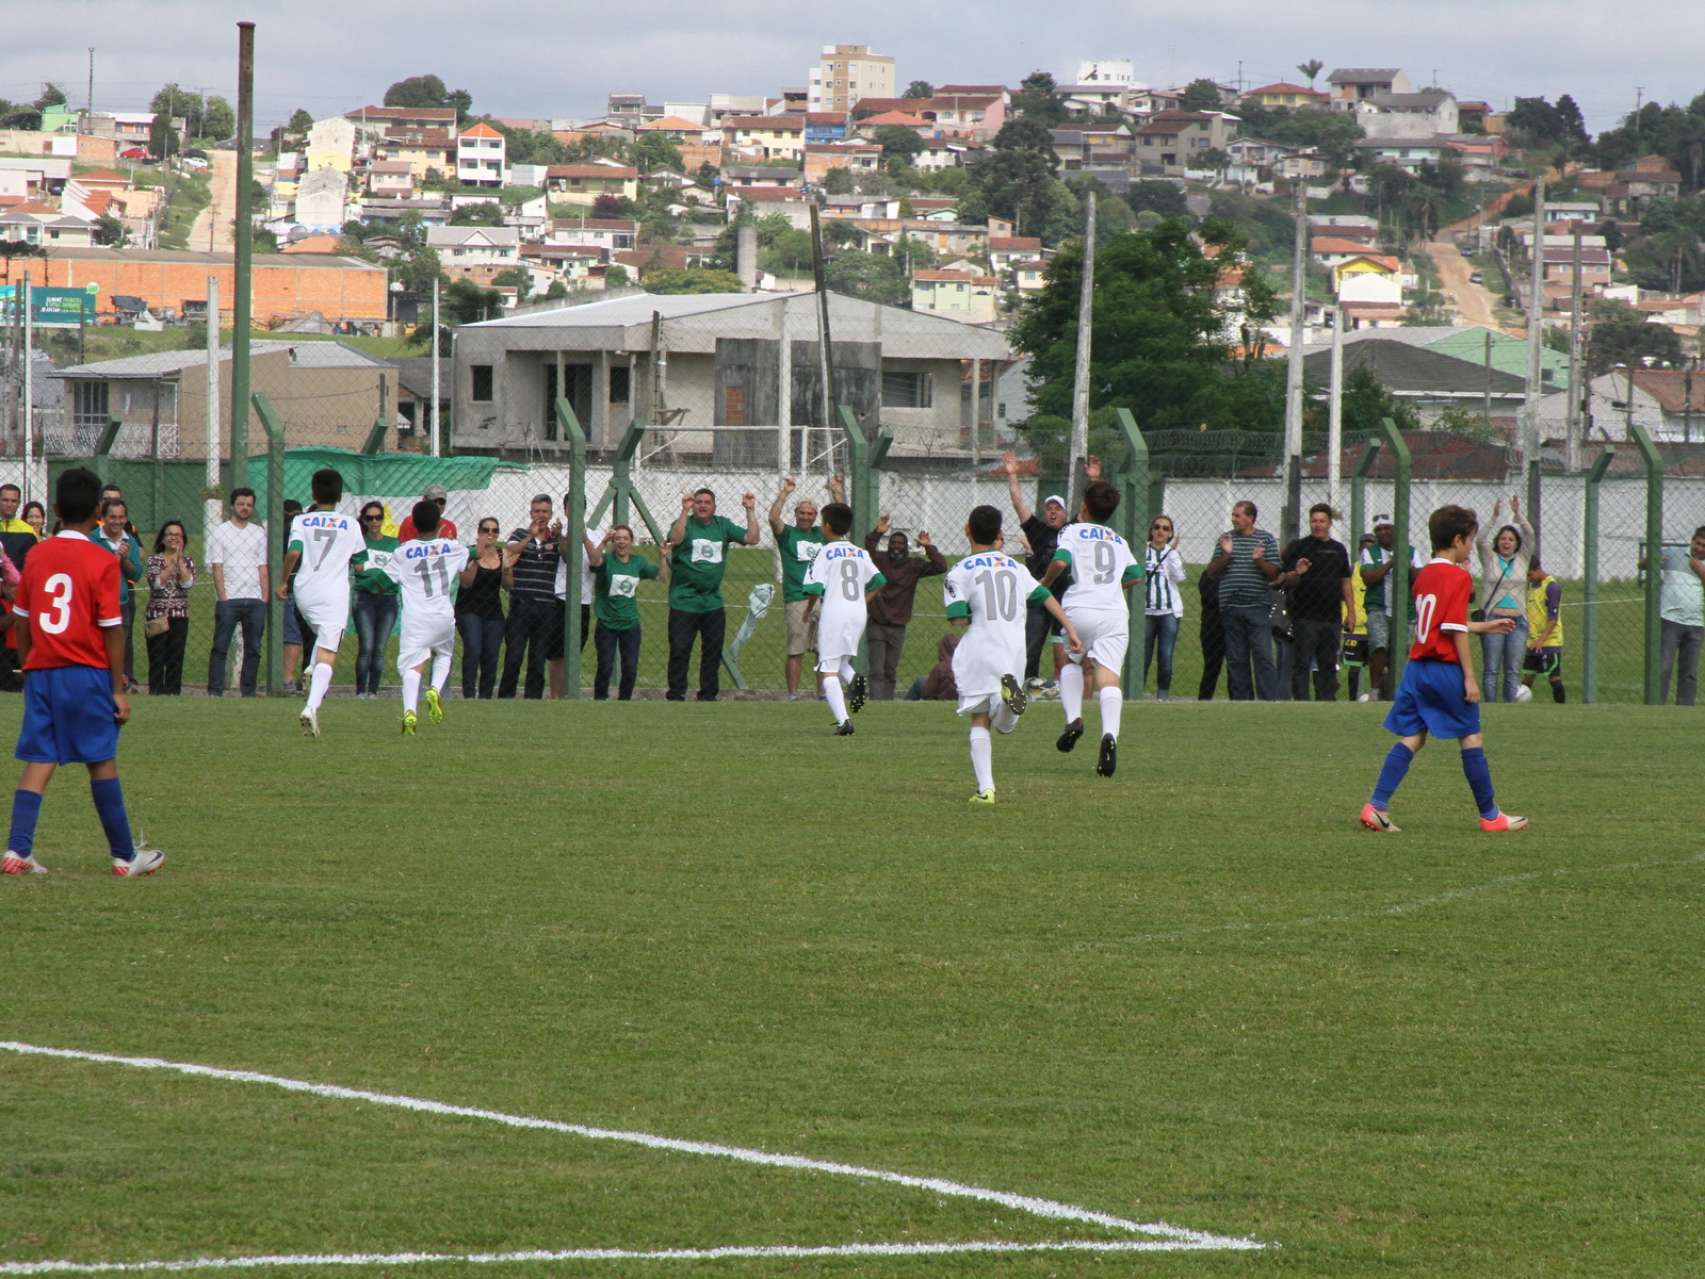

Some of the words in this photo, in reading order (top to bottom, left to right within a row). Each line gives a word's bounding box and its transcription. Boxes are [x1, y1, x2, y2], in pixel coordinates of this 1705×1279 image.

[302, 517, 348, 530] CAIXA
[1080, 527, 1123, 545] CAIXA
[313, 528, 338, 572] 7
[406, 543, 450, 559] CAIXA
[825, 547, 864, 560] CAIXA
[963, 556, 1017, 570] CAIXA
[1093, 541, 1116, 585] 9
[414, 556, 451, 598] 11
[840, 559, 860, 601] 8
[975, 570, 1018, 622] 10
[39, 573, 73, 635] 3
